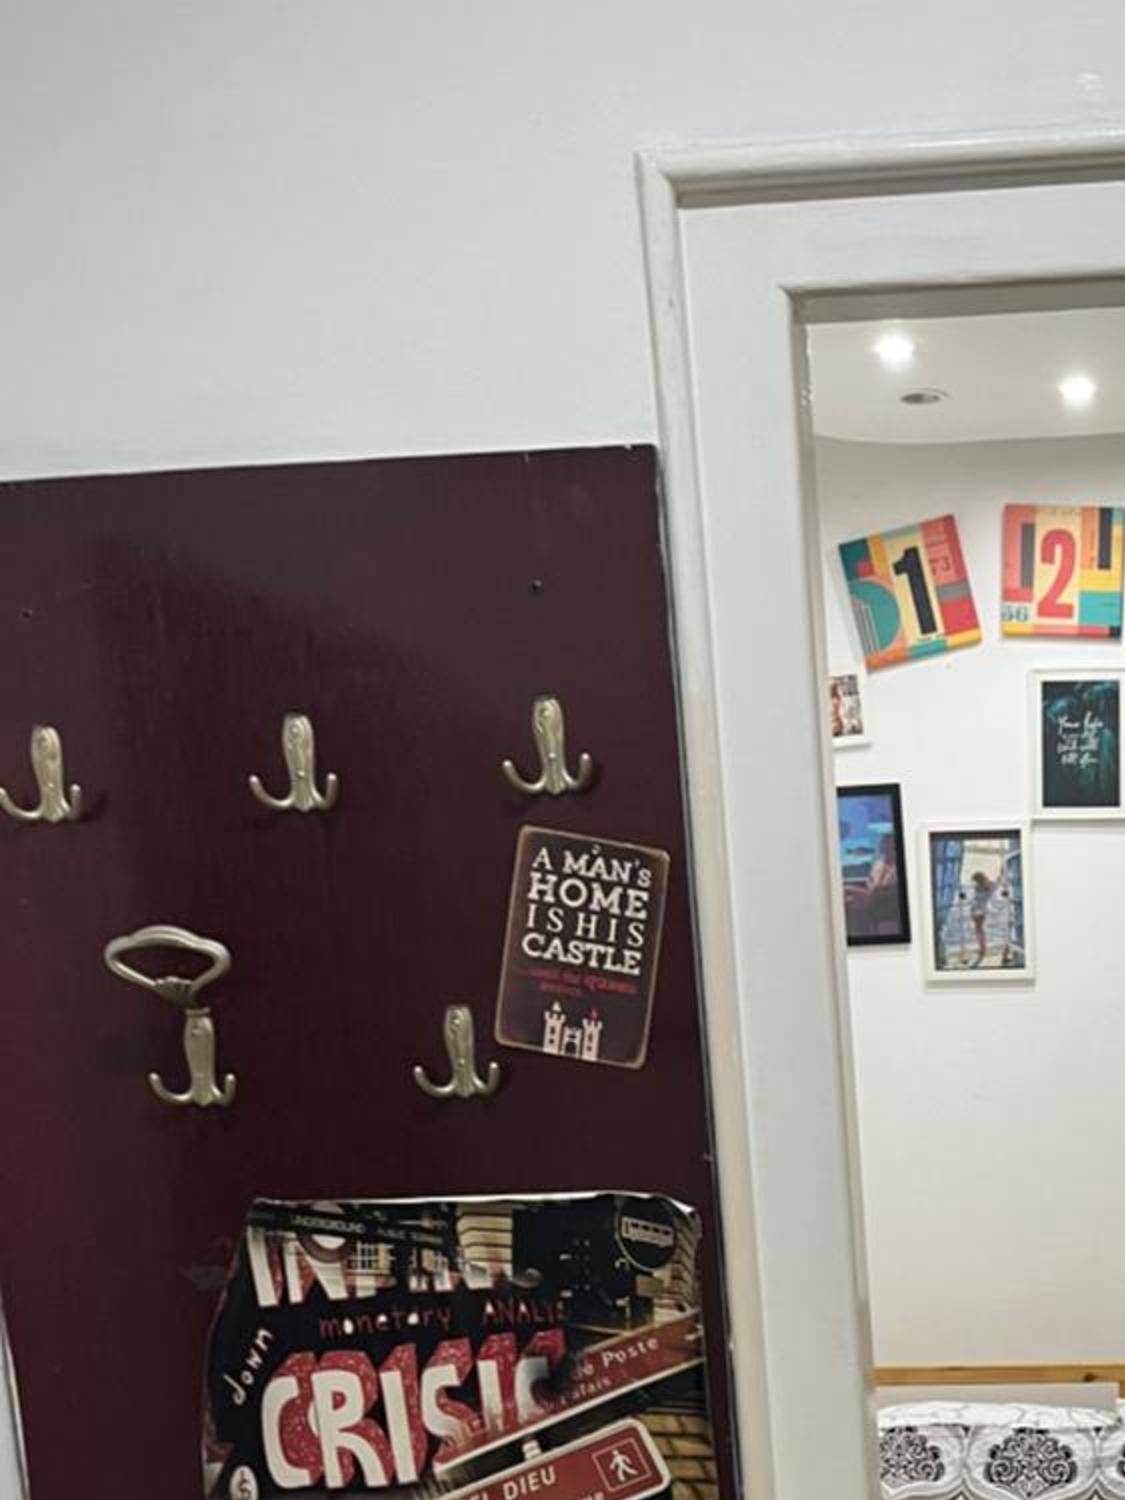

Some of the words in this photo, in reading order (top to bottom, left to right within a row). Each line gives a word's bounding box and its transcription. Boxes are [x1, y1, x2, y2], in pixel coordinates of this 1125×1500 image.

[893, 545, 938, 635] 1
[1037, 528, 1076, 619] 2
[532, 847, 554, 870] A
[562, 850, 653, 888] MAN'S
[527, 871, 651, 920] HOME
[526, 903, 564, 933] IS
[575, 912, 645, 948] HIS
[521, 931, 643, 976] CASTLE
[319, 1306, 451, 1338] monetary
[601, 1337, 660, 1369] Poste
[502, 1465, 558, 1500] DIEU
